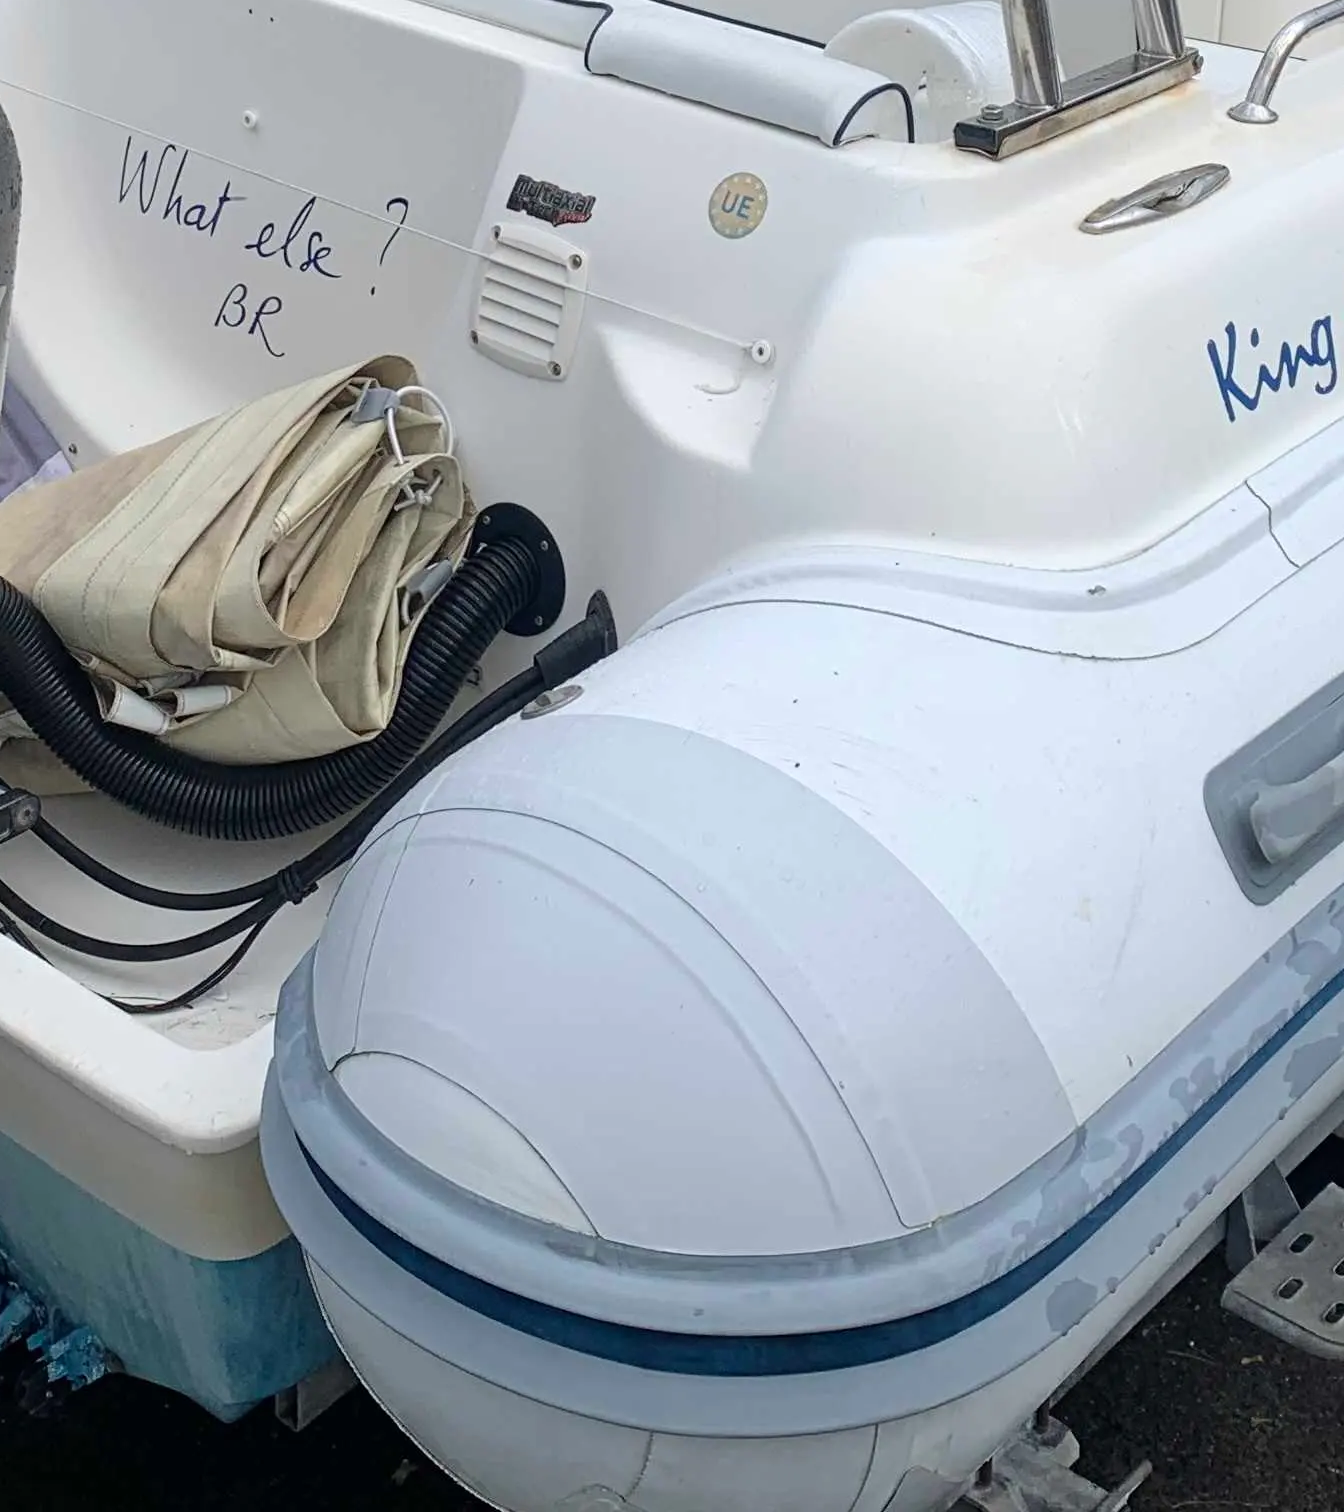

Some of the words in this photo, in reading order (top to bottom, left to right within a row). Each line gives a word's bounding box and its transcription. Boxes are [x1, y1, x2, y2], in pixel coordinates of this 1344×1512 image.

[118, 135, 247, 237] What
[244, 195, 343, 278] else
[721, 189, 755, 220] UE
[1207, 315, 1338, 422] King
